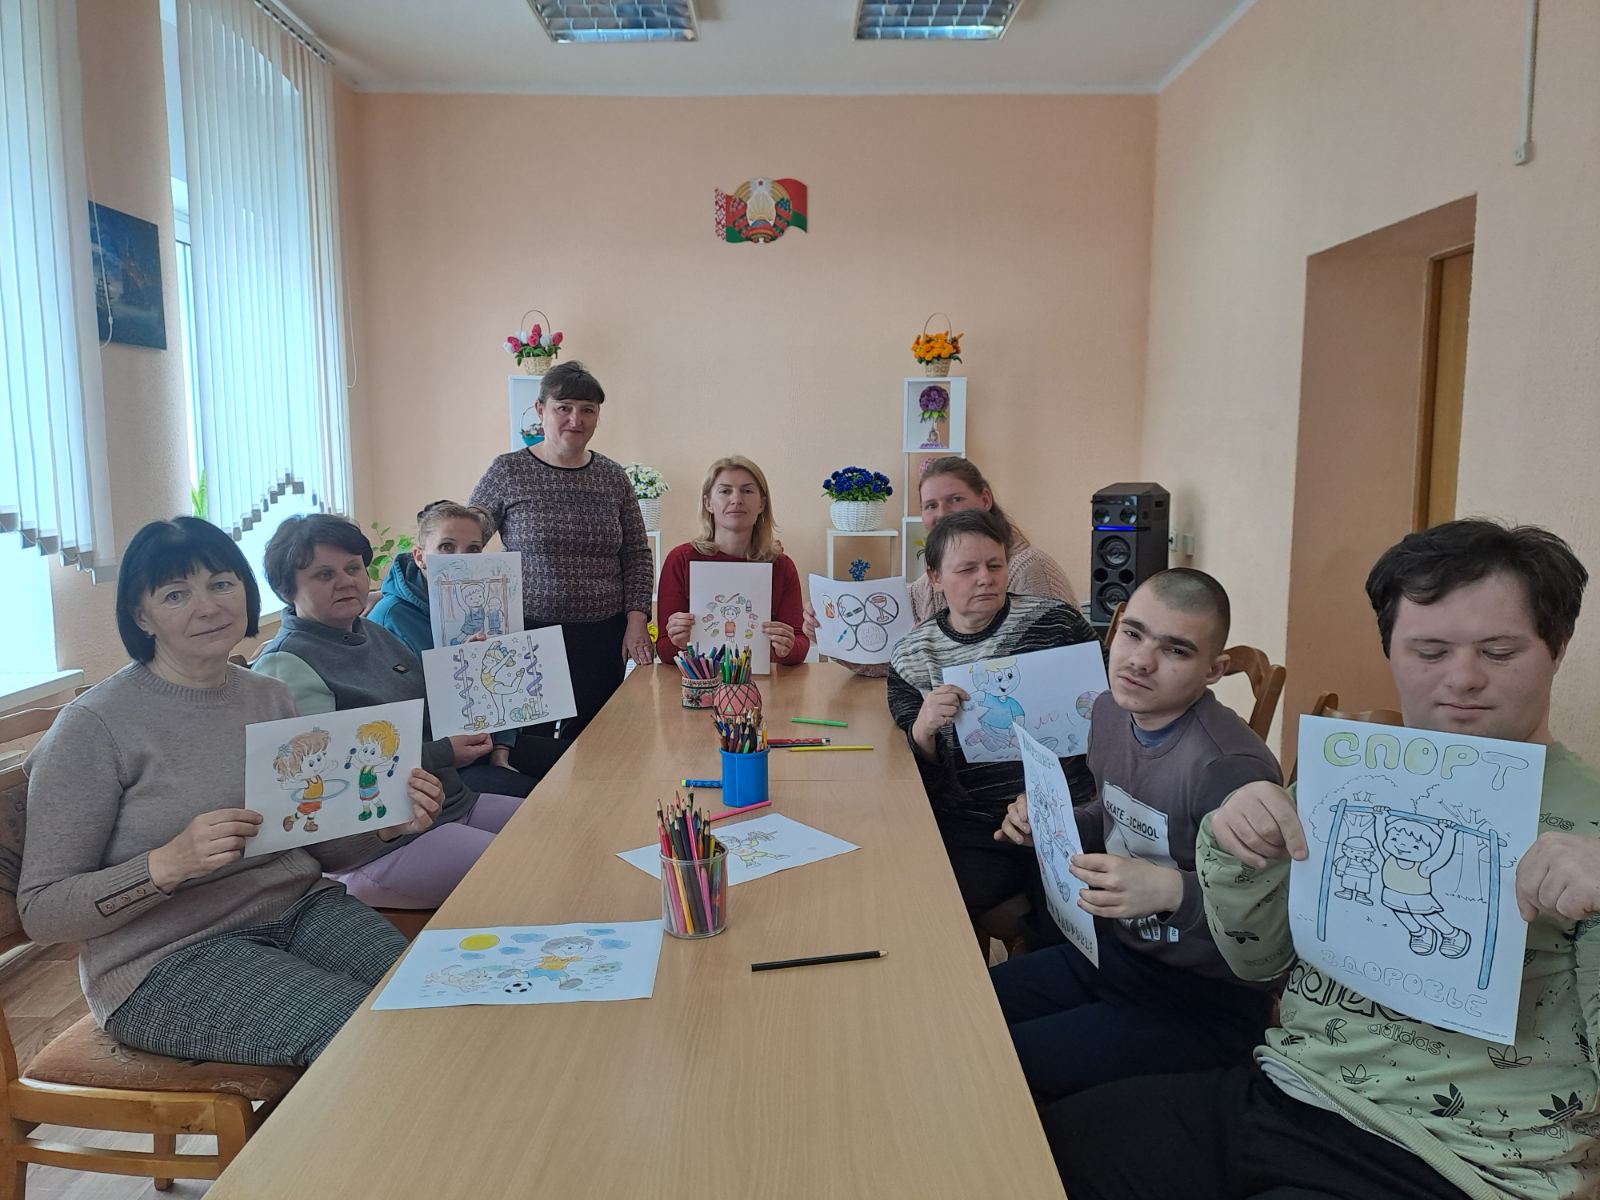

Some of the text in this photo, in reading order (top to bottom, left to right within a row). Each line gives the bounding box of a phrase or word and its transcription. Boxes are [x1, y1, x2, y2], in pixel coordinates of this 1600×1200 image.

[1323, 731, 1529, 791] СПОРТ
[1105, 800, 1126, 821] SKATE
[1320, 949, 1488, 1018] ЗДОРОВЬЕ
[1367, 1021, 1447, 1056] adidas
